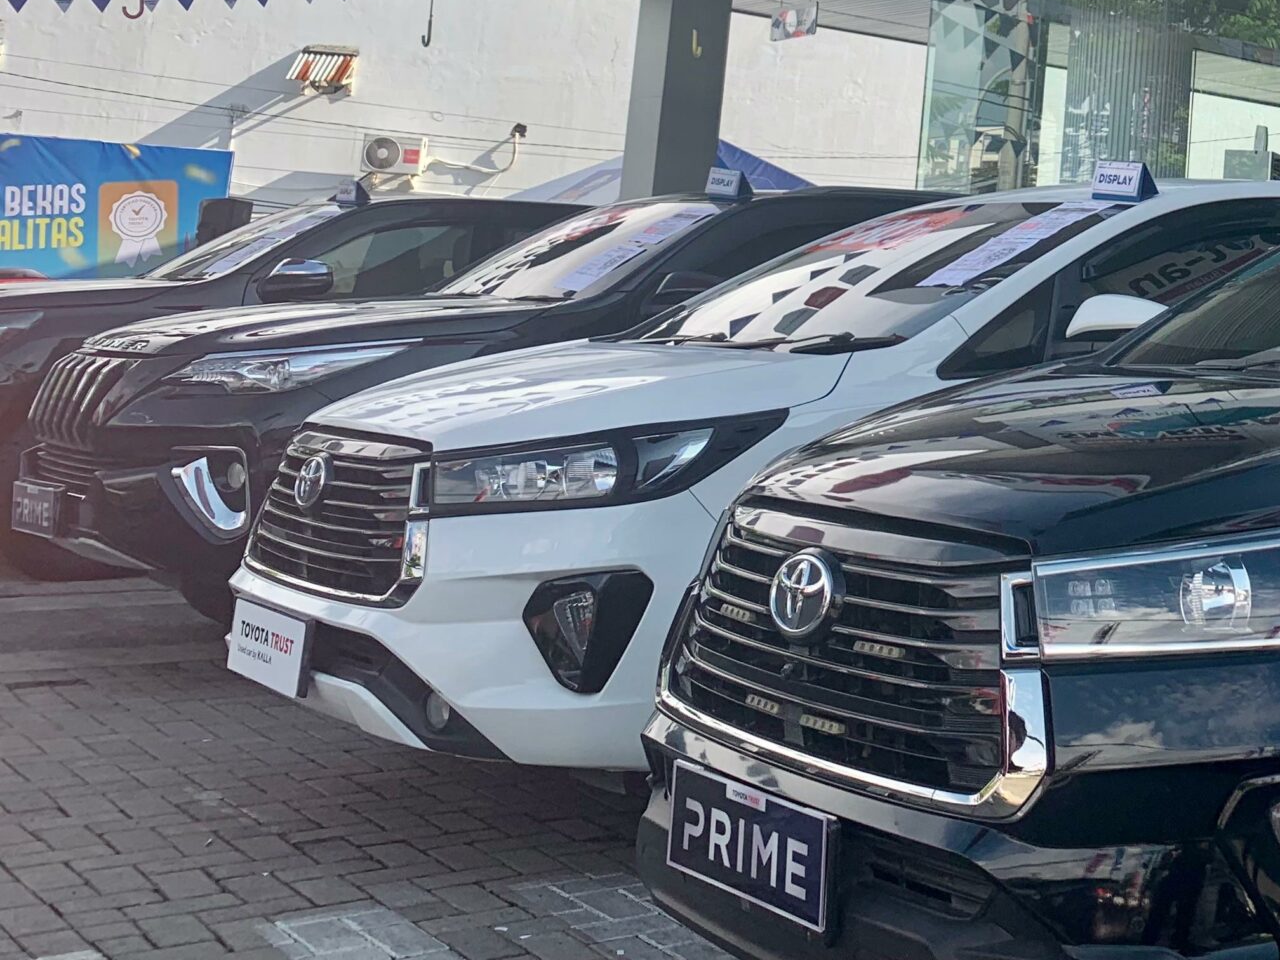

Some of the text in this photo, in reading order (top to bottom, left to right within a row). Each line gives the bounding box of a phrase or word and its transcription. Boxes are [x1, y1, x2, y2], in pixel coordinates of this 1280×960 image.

[1098, 173, 1134, 186] DISPLAY
[4, 183, 87, 217] BEKAS
[15, 497, 49, 527] PRIME
[241, 620, 294, 656] TOYOTA TRUST
[257, 650, 272, 665] KALLA
[732, 789, 748, 801] TOYOTA
[682, 797, 808, 901] PRIME
